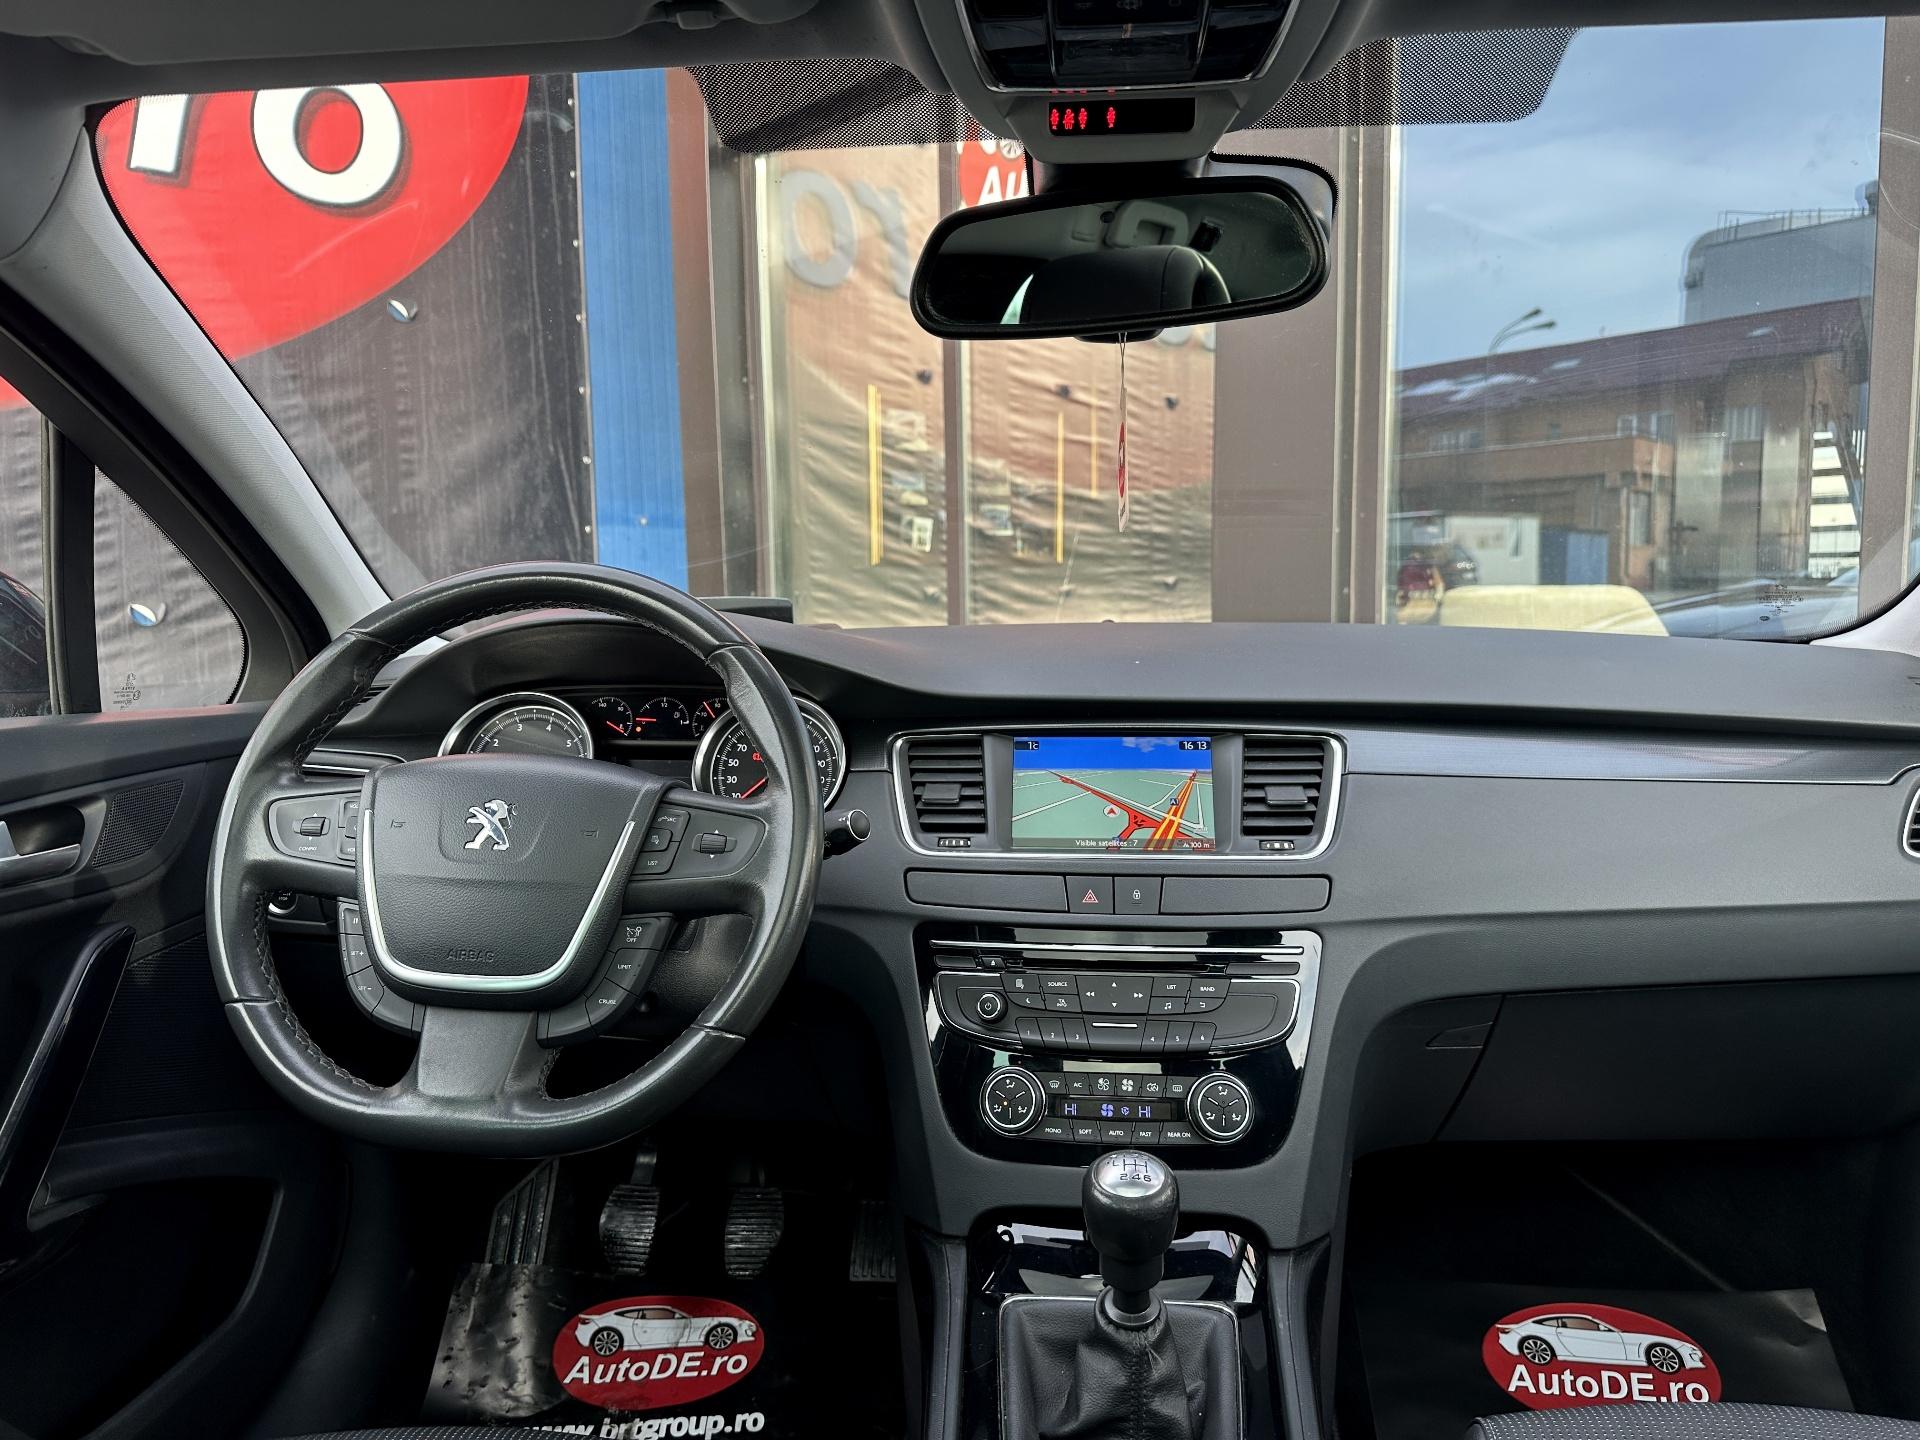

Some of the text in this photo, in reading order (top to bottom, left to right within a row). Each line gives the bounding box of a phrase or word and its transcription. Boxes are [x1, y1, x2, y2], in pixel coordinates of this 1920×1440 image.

[517, 724, 522, 732] 3
[546, 724, 551, 732] 4
[494, 739, 499, 747] 2
[566, 740, 572, 748] 5
[1183, 741, 1207, 750] 16 13
[737, 744, 748, 752] 70
[728, 759, 739, 767] 50
[726, 776, 737, 784] 30
[1075, 839, 1097, 847] Visible
[1098, 839, 1128, 847] satellites
[1133, 839, 1139, 847] 7
[446, 949, 494, 962] AIRBAG
[1064, 1103, 1077, 1116] HI
[1138, 1105, 1151, 1118] HI
[1120, 1173, 1152, 1182] 2 4 6
[562, 1351, 748, 1385] AutoDE.ro
[1507, 1363, 1710, 1403] AutoDE.ro
